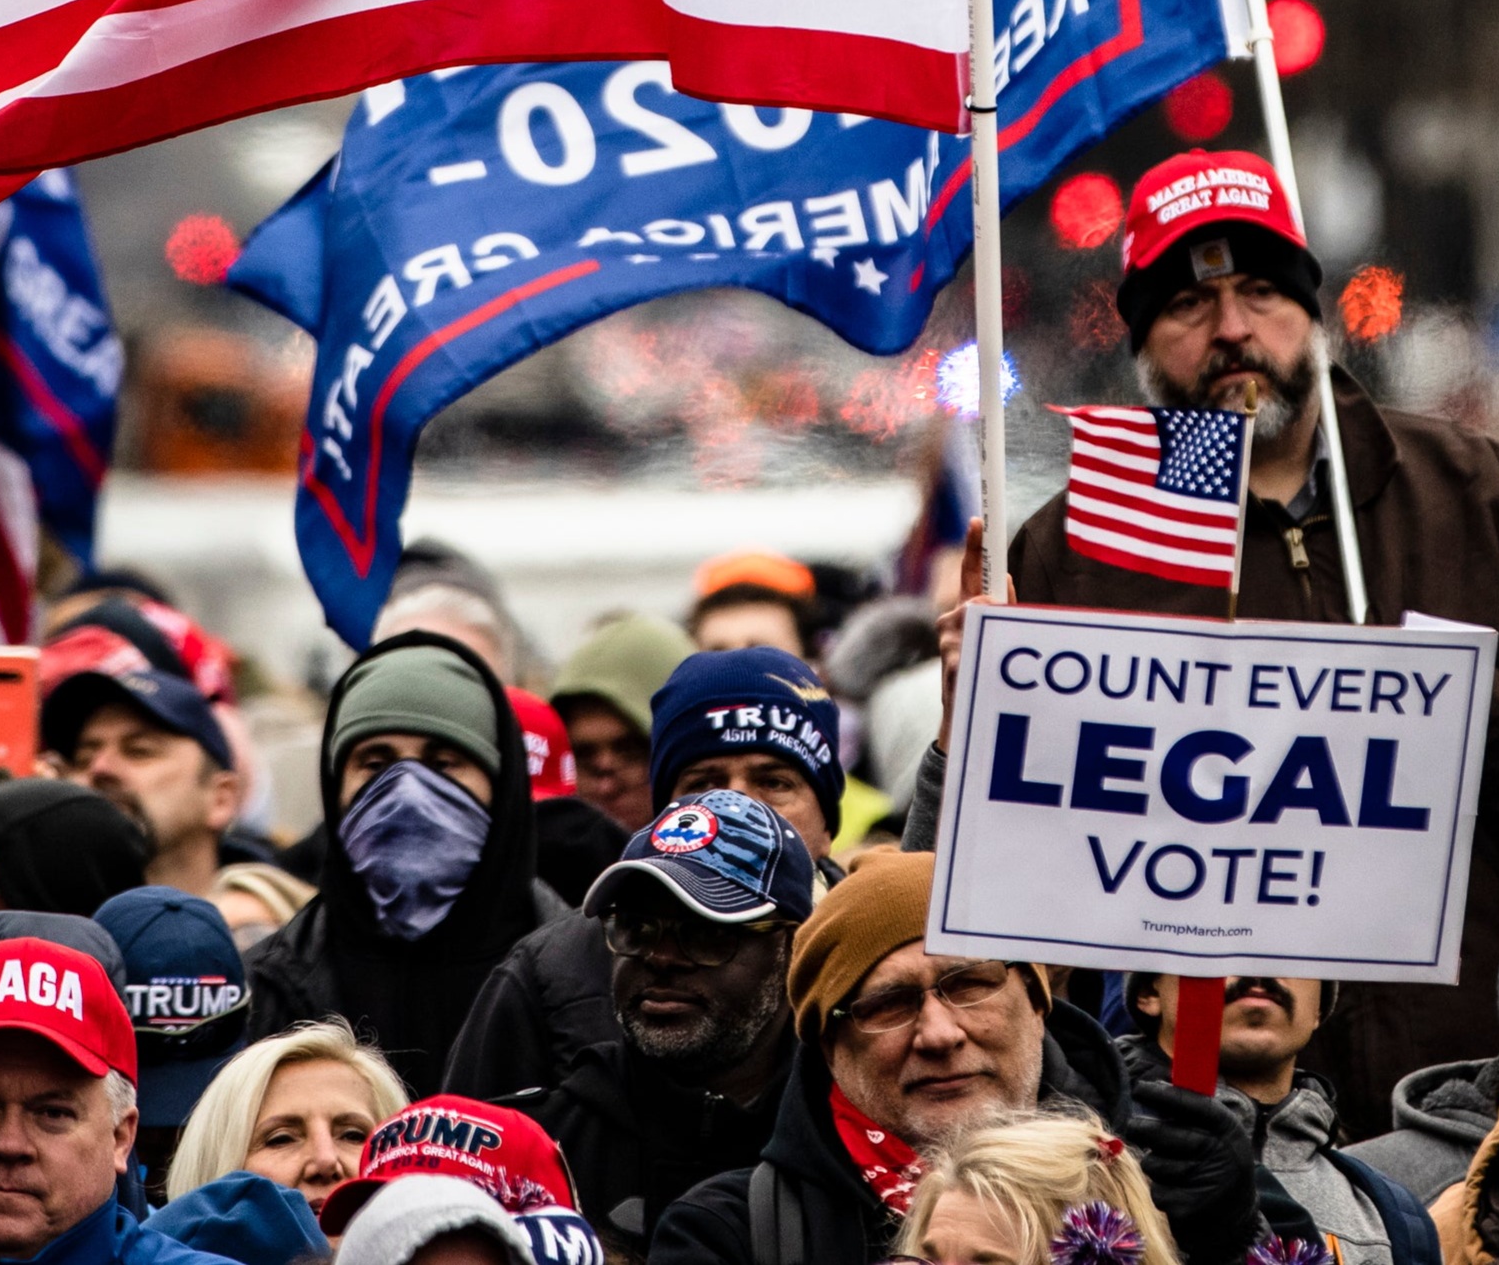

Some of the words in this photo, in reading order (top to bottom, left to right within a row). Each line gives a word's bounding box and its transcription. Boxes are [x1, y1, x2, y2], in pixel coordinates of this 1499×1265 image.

[1147, 175, 1196, 214] MAKE
[1196, 168, 1273, 195] AMERICA
[1157, 189, 1213, 225] GREAT
[1216, 187, 1270, 211] AGAIN
[1000, 647, 1231, 706] COUNT
[1247, 664, 1451, 717] EVERY
[706, 706, 832, 765] TRUMP
[721, 728, 758, 743] 45TH
[988, 713, 1431, 831] LEGAL
[1087, 835, 1325, 907] VOTE!
[1142, 920, 1253, 937] TrumpMarch.com
[125, 985, 241, 1018] TRUMP
[368, 1113, 502, 1162] TRUMP
[421, 1144, 460, 1161] GREAT
